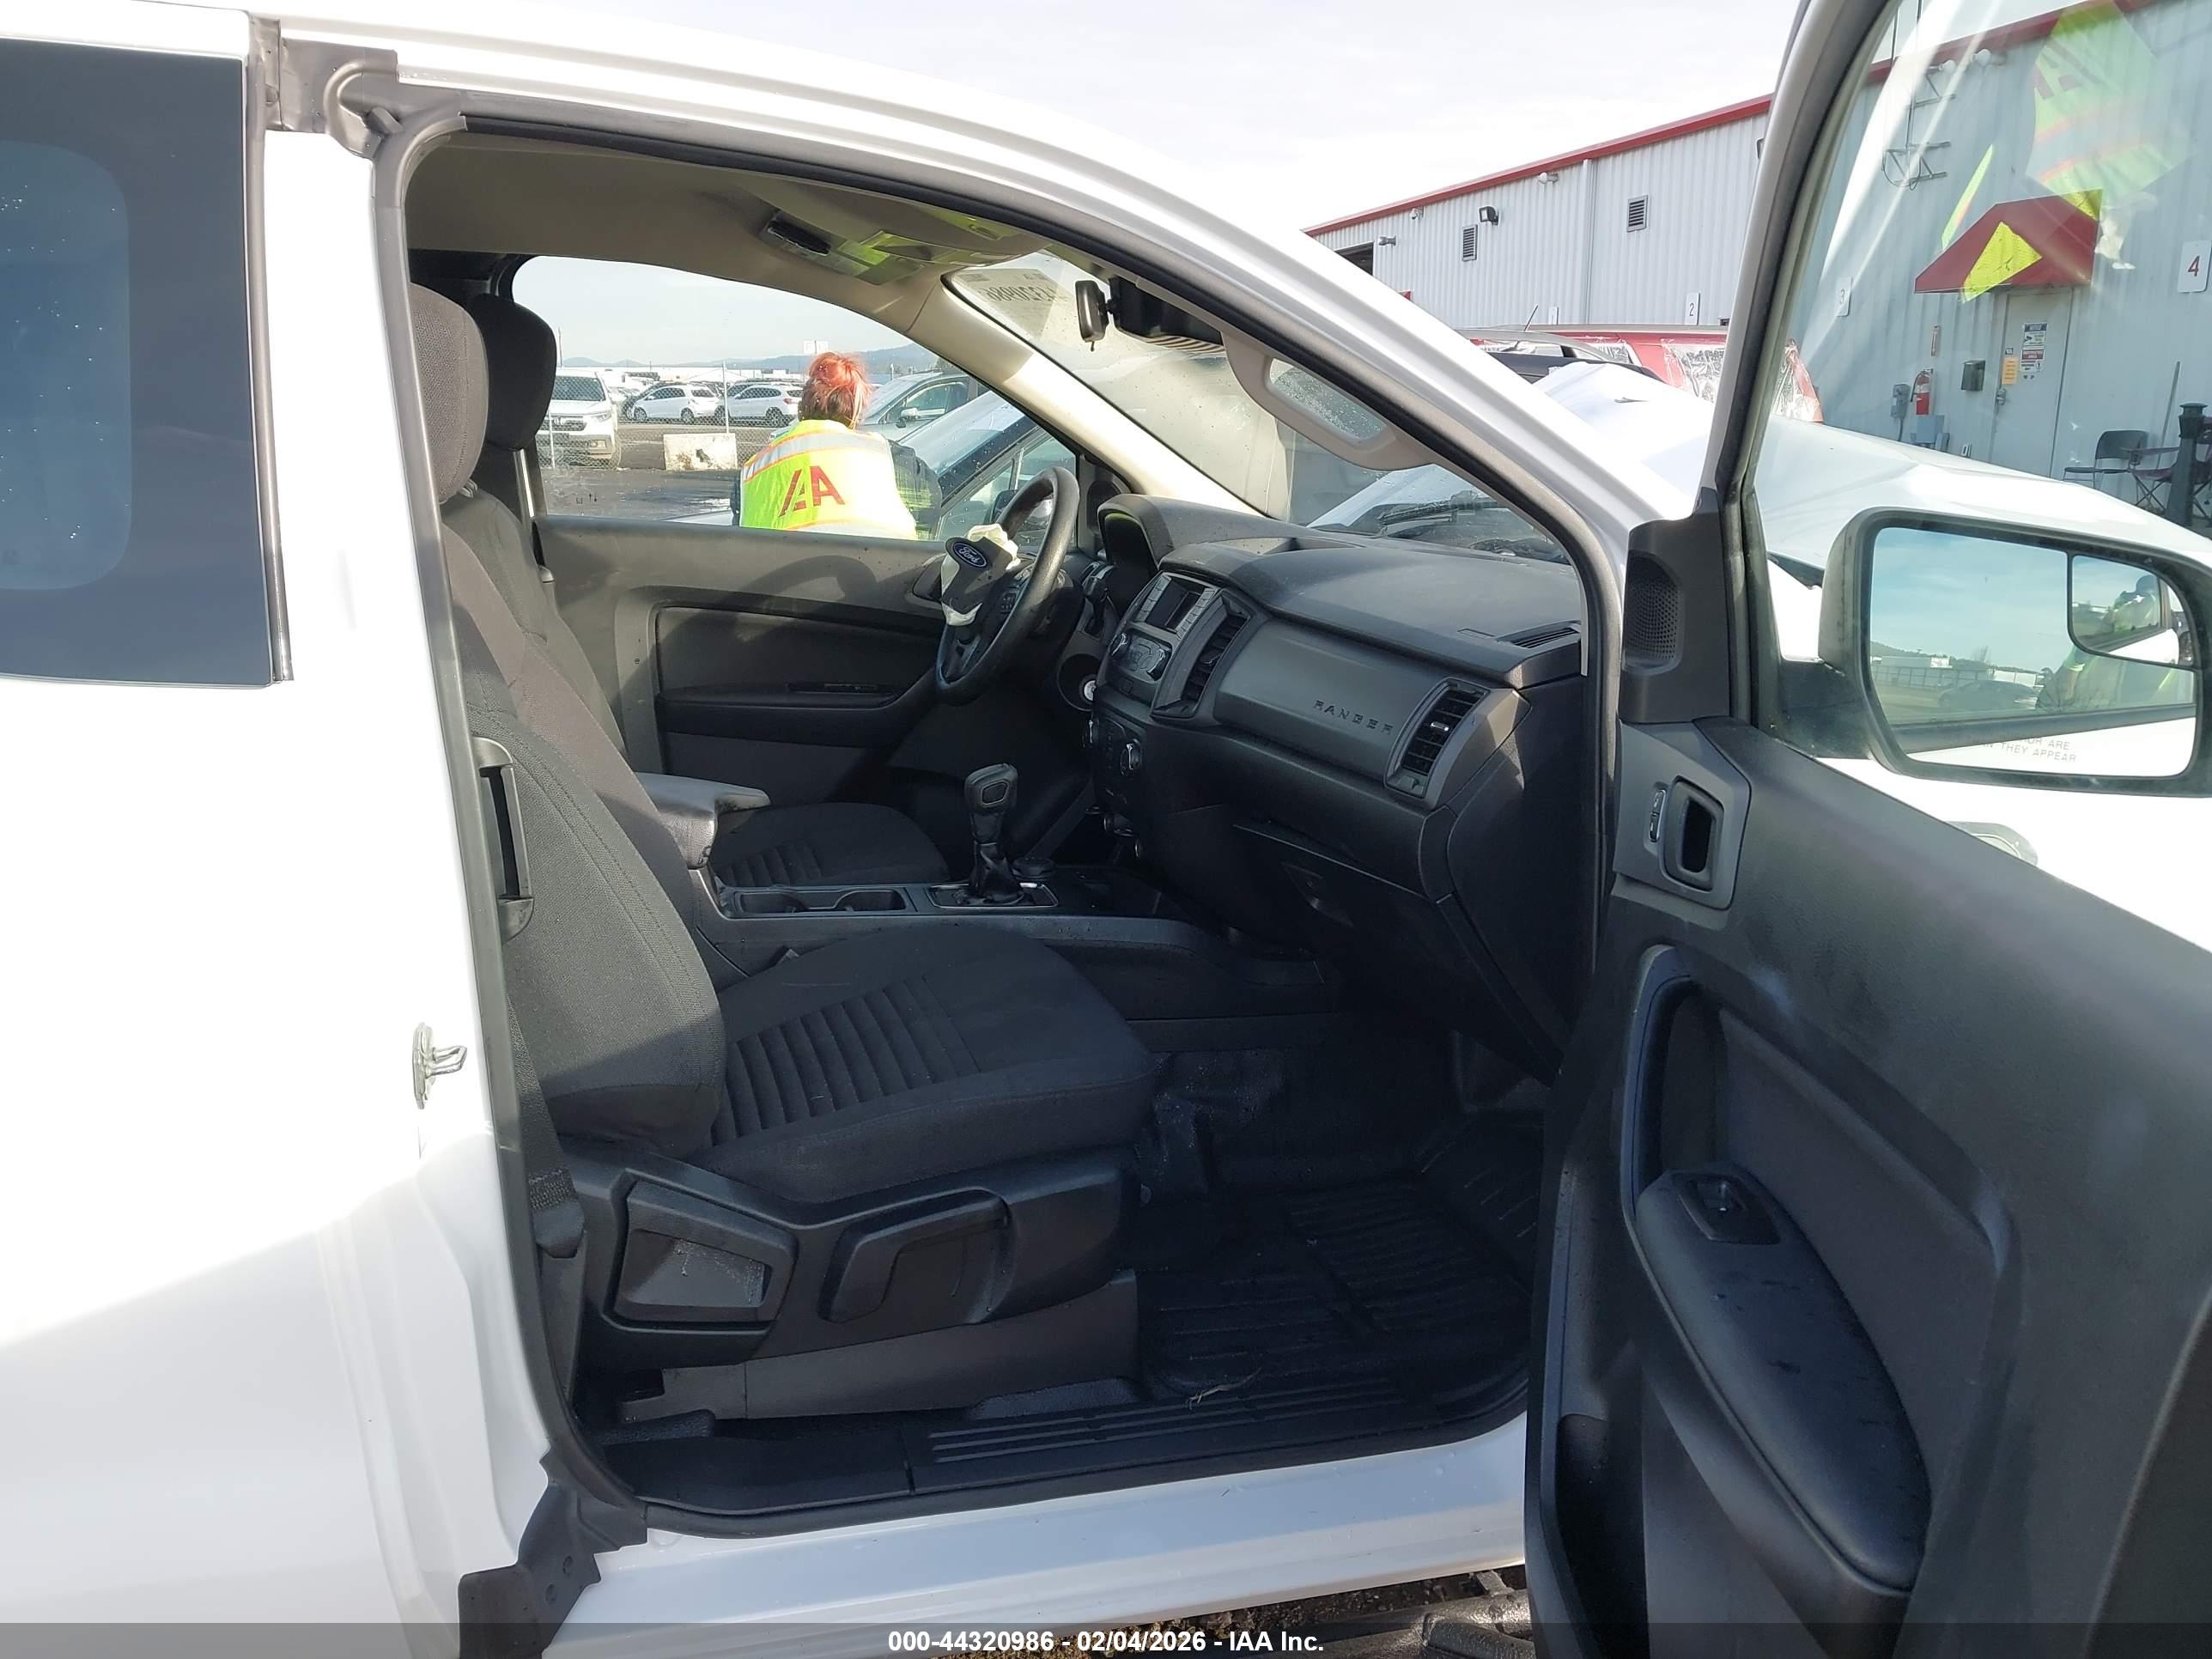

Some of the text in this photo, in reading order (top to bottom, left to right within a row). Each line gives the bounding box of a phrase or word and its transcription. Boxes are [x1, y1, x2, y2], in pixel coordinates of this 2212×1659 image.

[2187, 255, 2200, 277] 4
[1839, 288, 1845, 304] 3
[1689, 302, 1695, 317] 2
[1313, 700, 1395, 736] RANGER
[2000, 742, 2077, 763] THEY APPEAR
[2048, 738, 2072, 751] ARE
